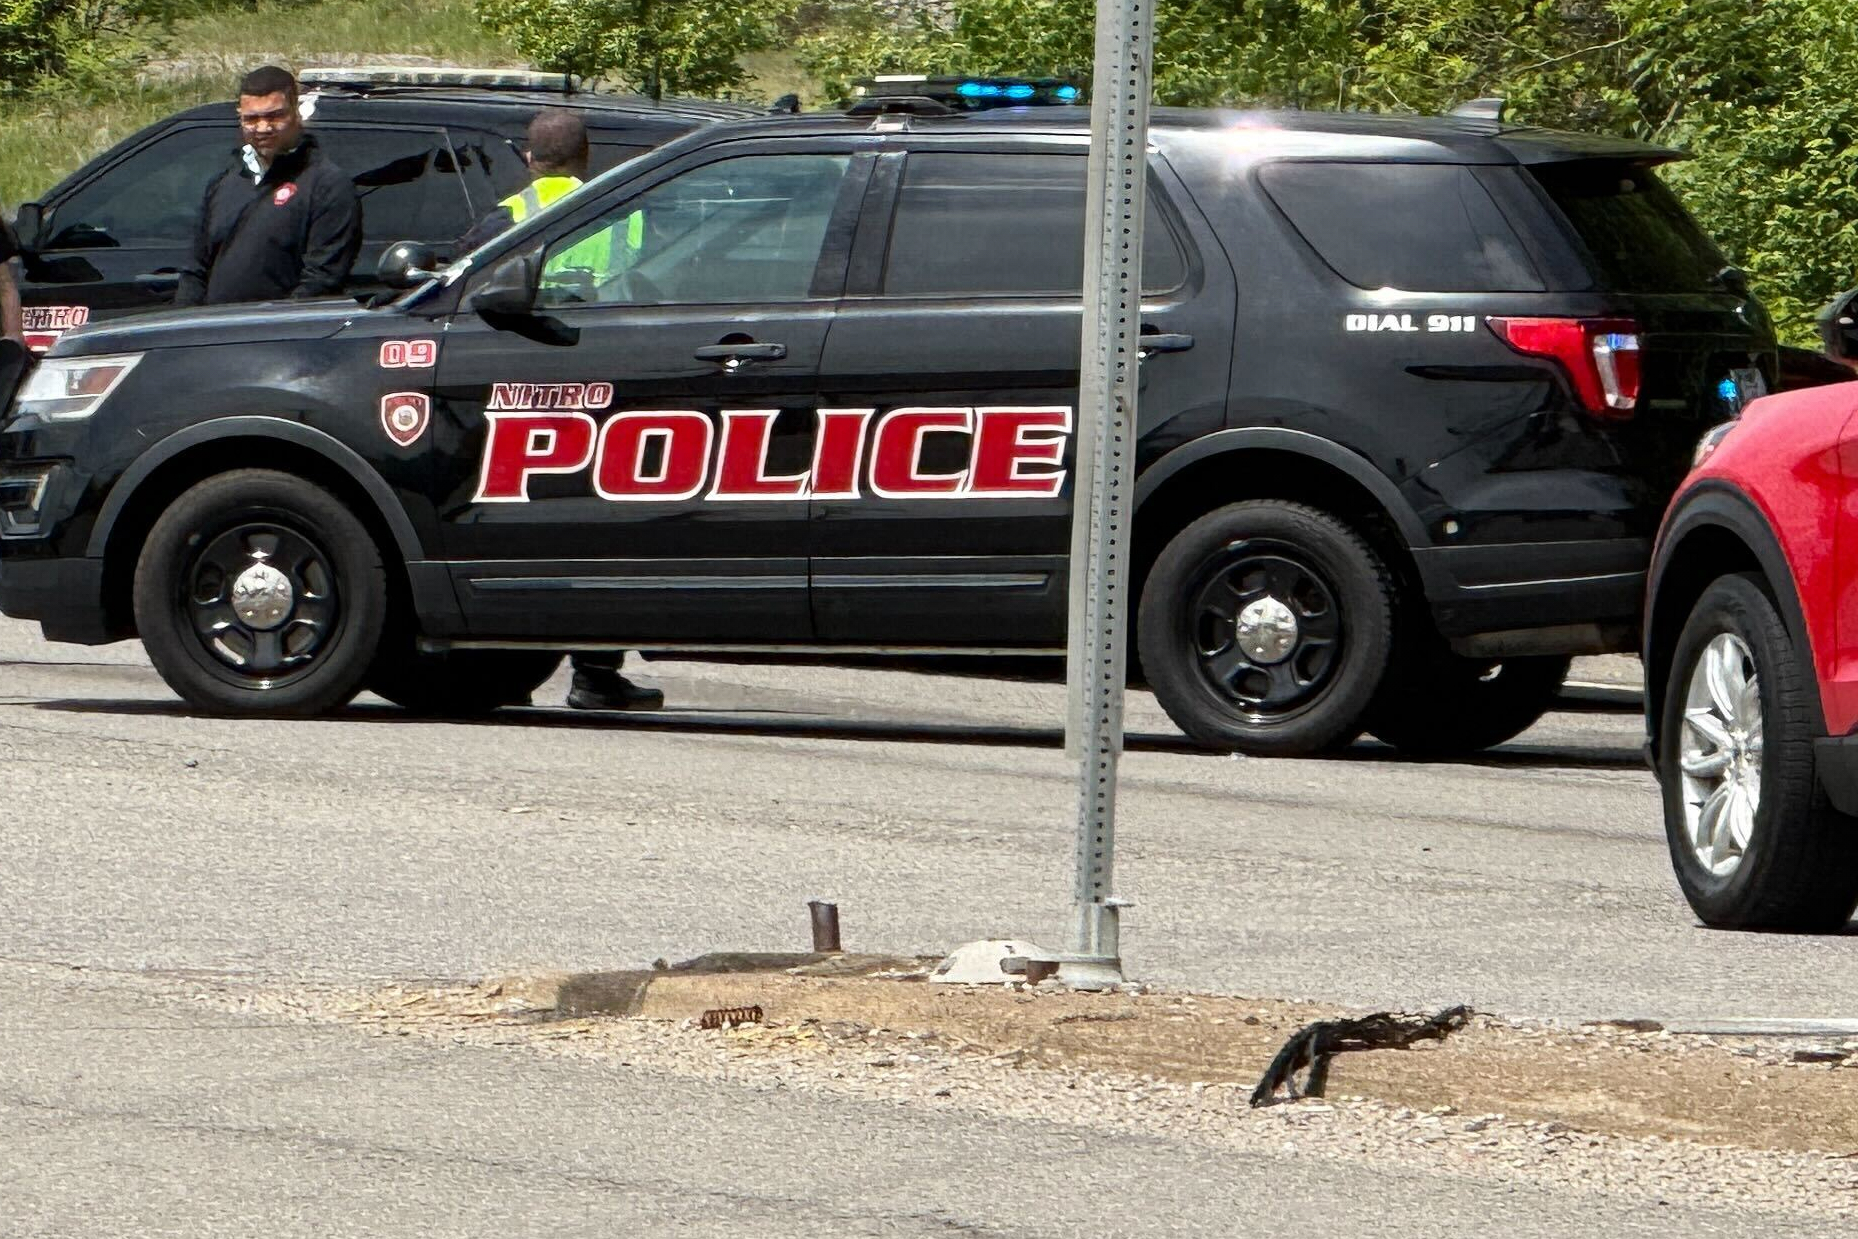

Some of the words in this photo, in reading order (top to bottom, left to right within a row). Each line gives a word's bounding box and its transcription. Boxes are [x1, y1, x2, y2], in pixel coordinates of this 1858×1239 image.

[1346, 313, 1419, 332] DIAL
[1427, 314, 1476, 332] 911
[380, 340, 436, 367] 09
[486, 382, 613, 409] NITRO
[471, 407, 1073, 502] POLICE
